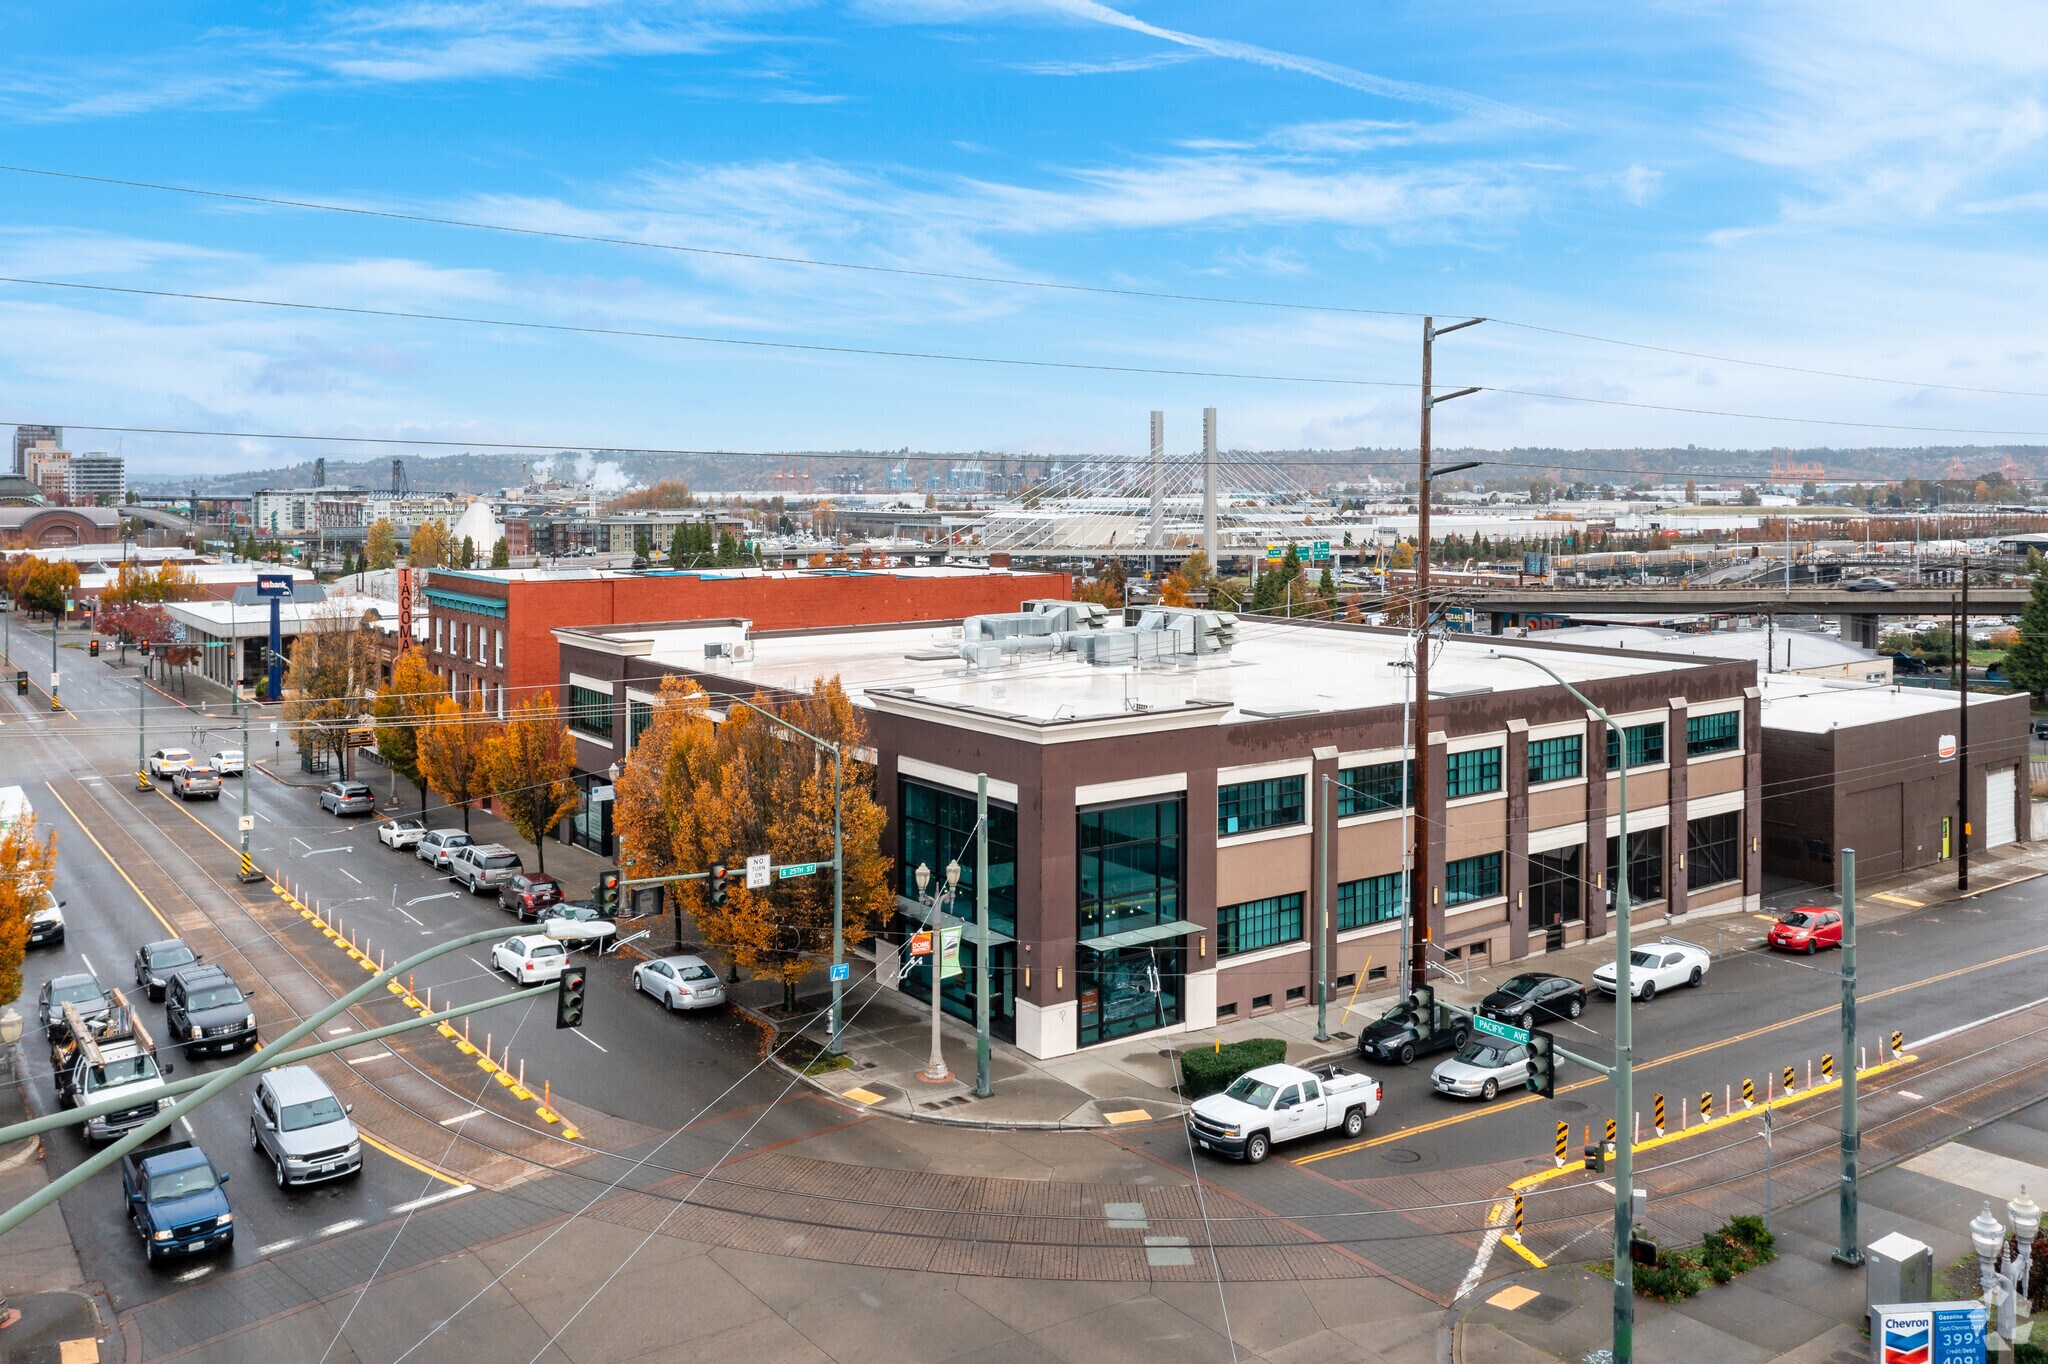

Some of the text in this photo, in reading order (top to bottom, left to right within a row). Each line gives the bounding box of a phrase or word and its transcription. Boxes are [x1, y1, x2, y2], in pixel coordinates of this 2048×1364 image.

[400, 568, 412, 653] TACOMA
[789, 867, 804, 875] 25TH
[1479, 1020, 1527, 1042] PACIFIC AVE
[1885, 1319, 1929, 1328] Chevron
[1943, 1332, 1973, 1346] 399
